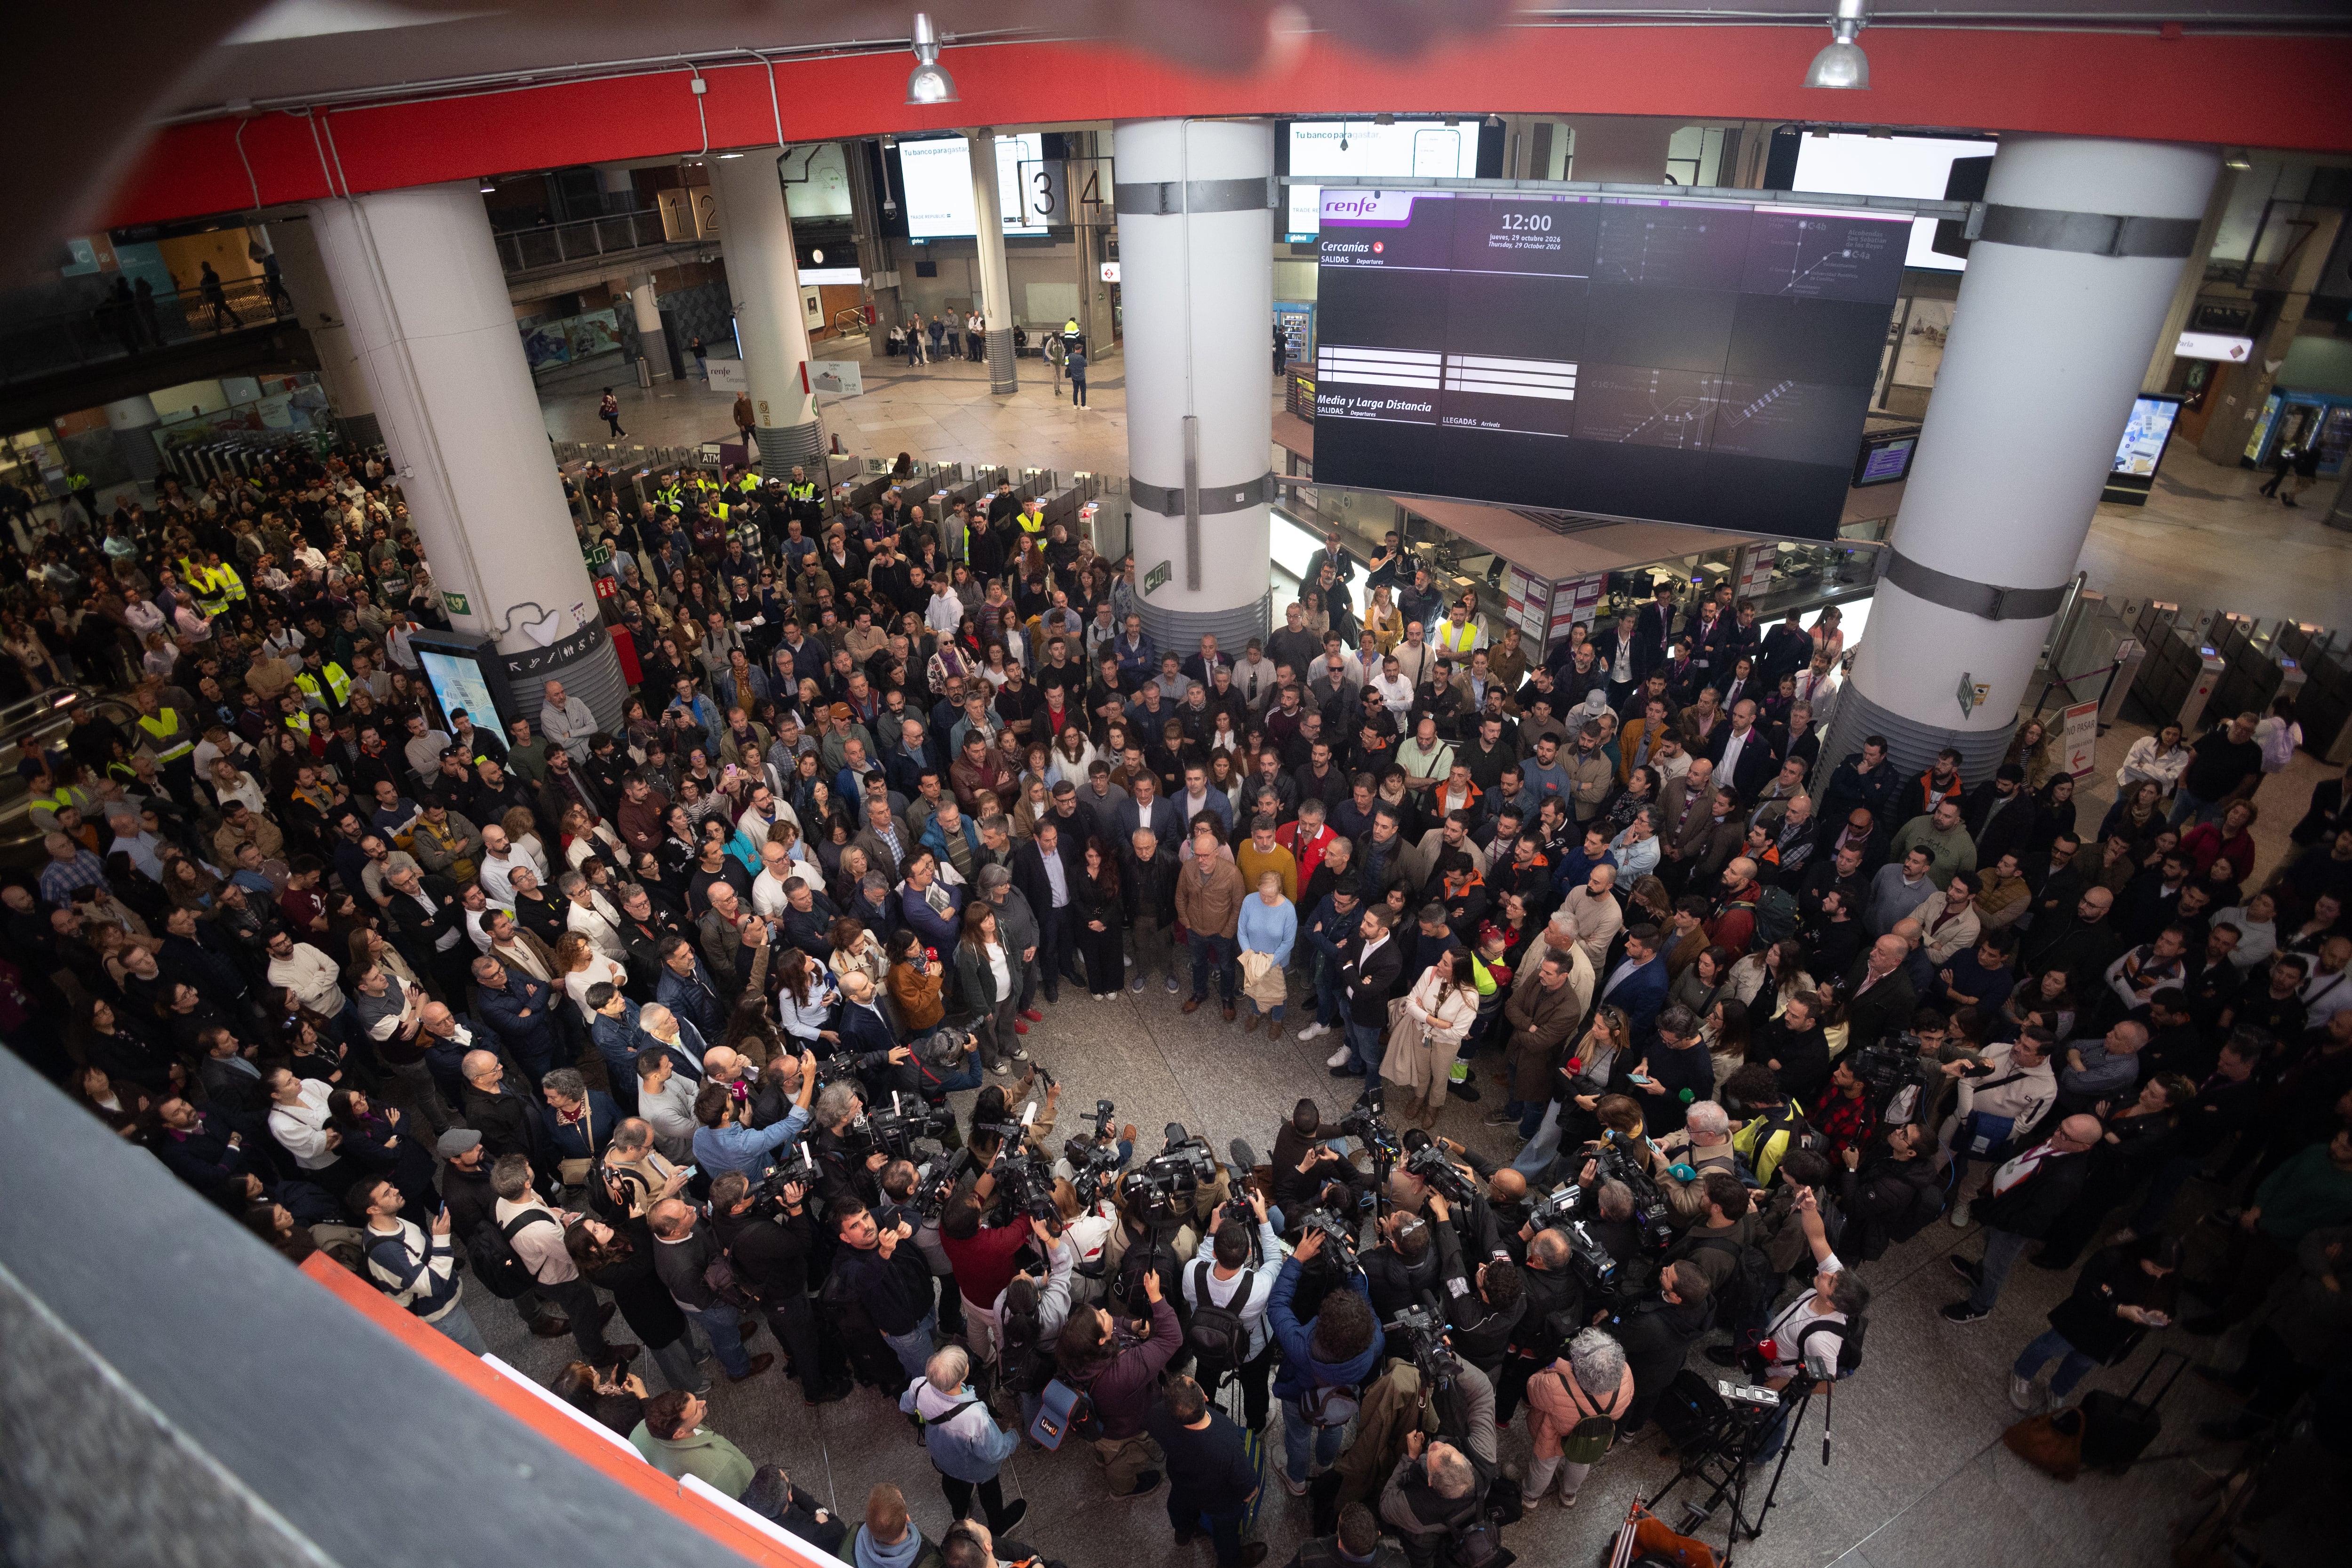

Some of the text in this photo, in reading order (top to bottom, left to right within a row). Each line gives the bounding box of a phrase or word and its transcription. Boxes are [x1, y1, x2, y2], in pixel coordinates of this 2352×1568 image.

[1033, 169, 1104, 215] 3 4
[669, 194, 719, 233] 1 2
[1325, 196, 1377, 217] renfe
[1502, 214, 1551, 231] 12:00
[1321, 241, 1369, 252] Cercanías
[2275, 218, 2320, 276] 7
[710, 366, 731, 377] renfe
[1317, 395, 1432, 412] Media y Larga Distancia
[1443, 416, 1477, 426] LLEGADAS
[702, 454, 720, 463] ATM
[2066, 719, 2096, 736] NO PASAR
[1916, 836, 1950, 857] adidas
[1041, 1418, 1057, 1435] LiveU
